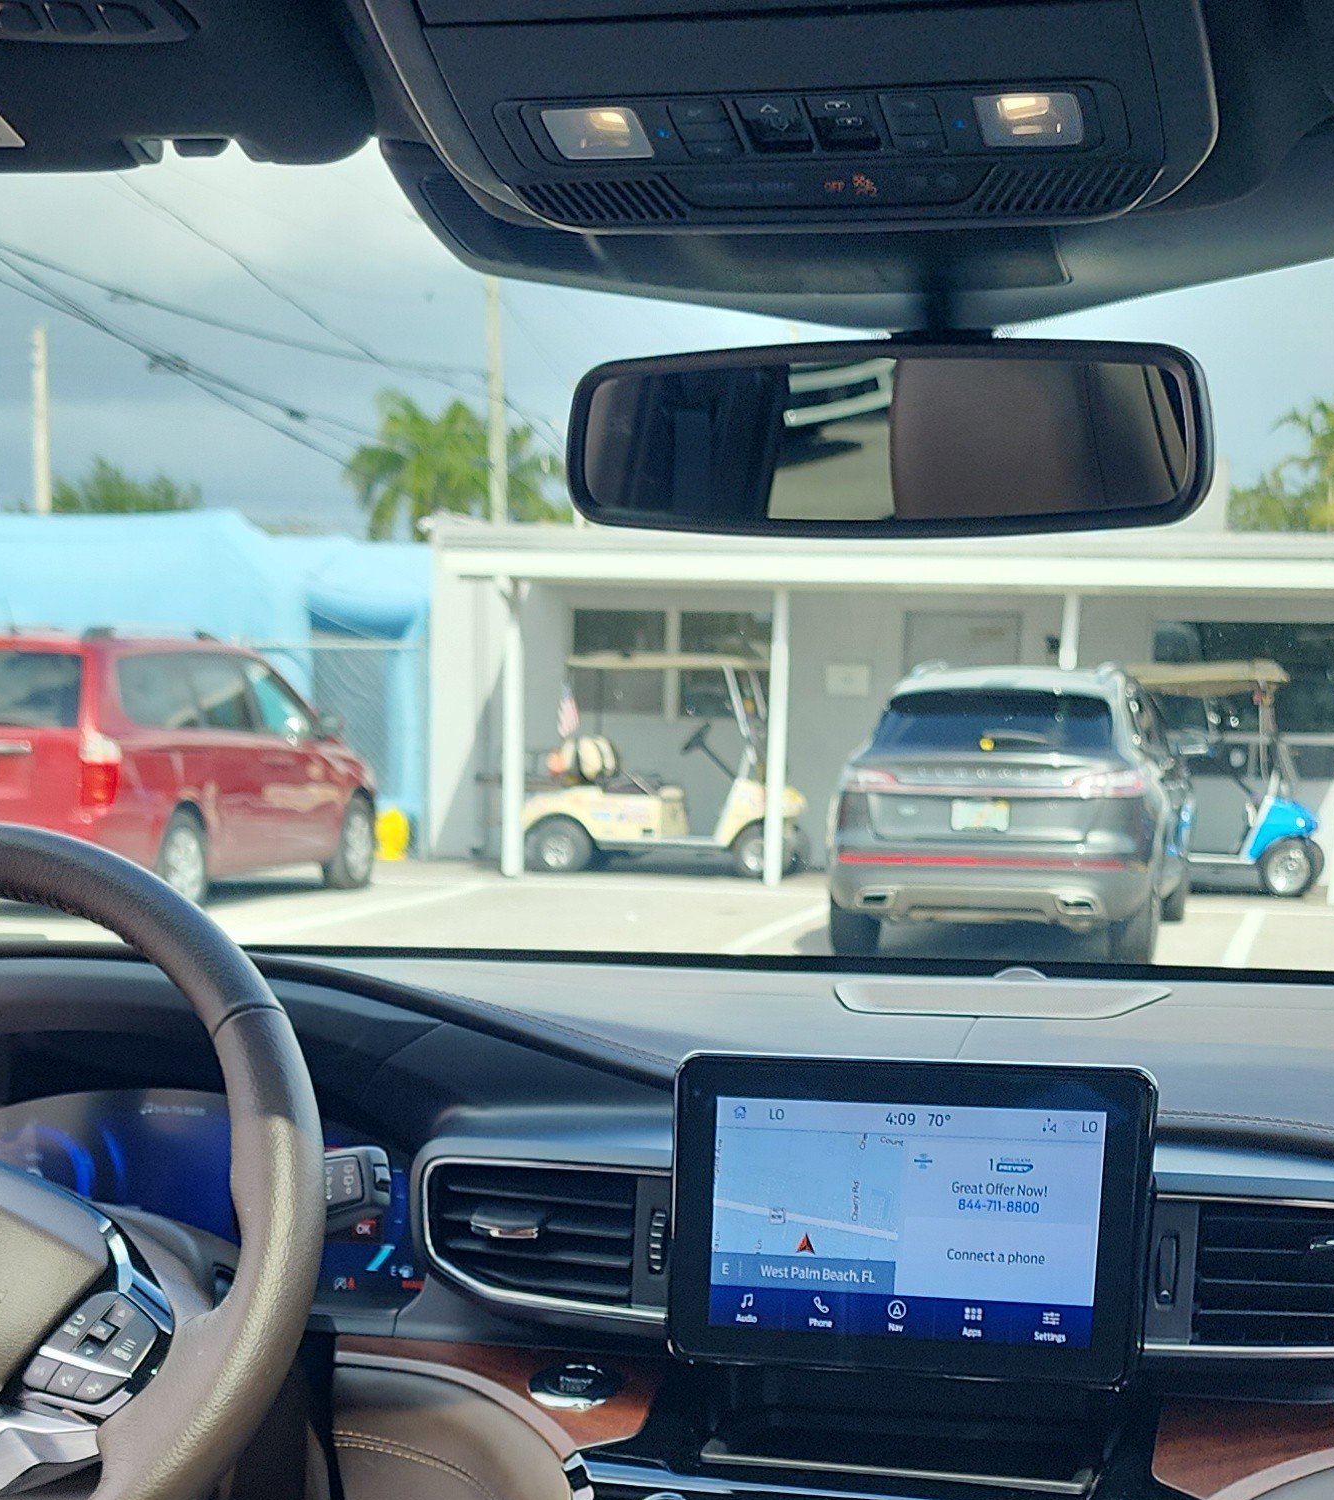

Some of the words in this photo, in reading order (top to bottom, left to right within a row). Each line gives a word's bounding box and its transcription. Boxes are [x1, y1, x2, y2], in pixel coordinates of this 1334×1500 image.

[769, 1108, 785, 1121] LO
[885, 1112, 916, 1126] 4:09
[927, 1113, 951, 1127] 70°
[1081, 1121, 1099, 1133] LO
[851, 1180, 861, 1194] Rd
[951, 1181, 983, 1195] Great
[985, 1183, 1015, 1196] Offer
[1017, 1185, 1049, 1198] Now!
[851, 1195, 861, 1222] Cherry
[958, 1199, 1040, 1214] 844-711-8800
[356, 1223, 372, 1236] OK
[946, 1248, 995, 1263] Connect
[997, 1253, 1005, 1263] a
[1007, 1251, 1046, 1266] phone
[721, 1262, 729, 1275] E
[760, 1264, 789, 1279] West
[791, 1266, 821, 1280] Palm
[822, 1268, 860, 1283] Beach,
[862, 1272, 876, 1284] FL
[735, 1313, 758, 1324] Audio
[808, 1317, 833, 1329] Phone
[887, 1322, 904, 1333] Nav
[961, 1326, 983, 1339] Apps
[1033, 1331, 1067, 1344] Settings
